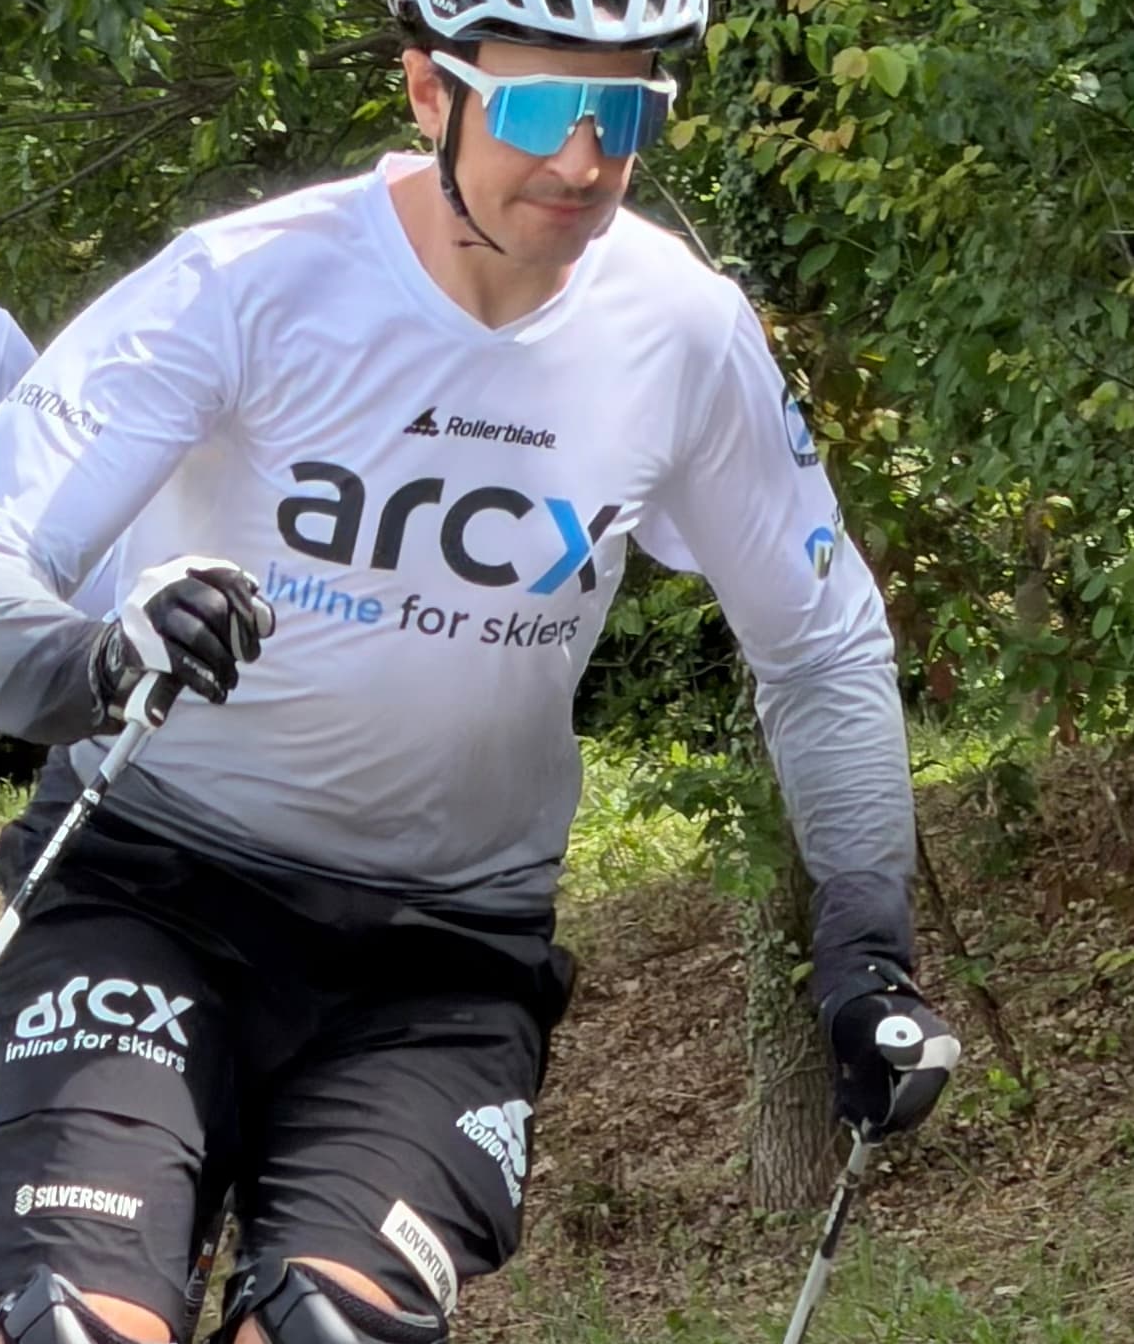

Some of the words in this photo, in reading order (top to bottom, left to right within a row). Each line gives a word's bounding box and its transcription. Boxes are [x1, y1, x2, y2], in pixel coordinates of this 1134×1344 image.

[444, 415, 558, 450] Rollerblade
[277, 461, 623, 595] arcx
[265, 561, 384, 625] inline
[399, 594, 470, 640] for
[480, 611, 582, 648] skiers
[5, 1037, 68, 1063] inline
[73, 1029, 112, 1050] for
[117, 1034, 186, 1073] skiers
[34, 1185, 138, 1220] SILVERSKIN
